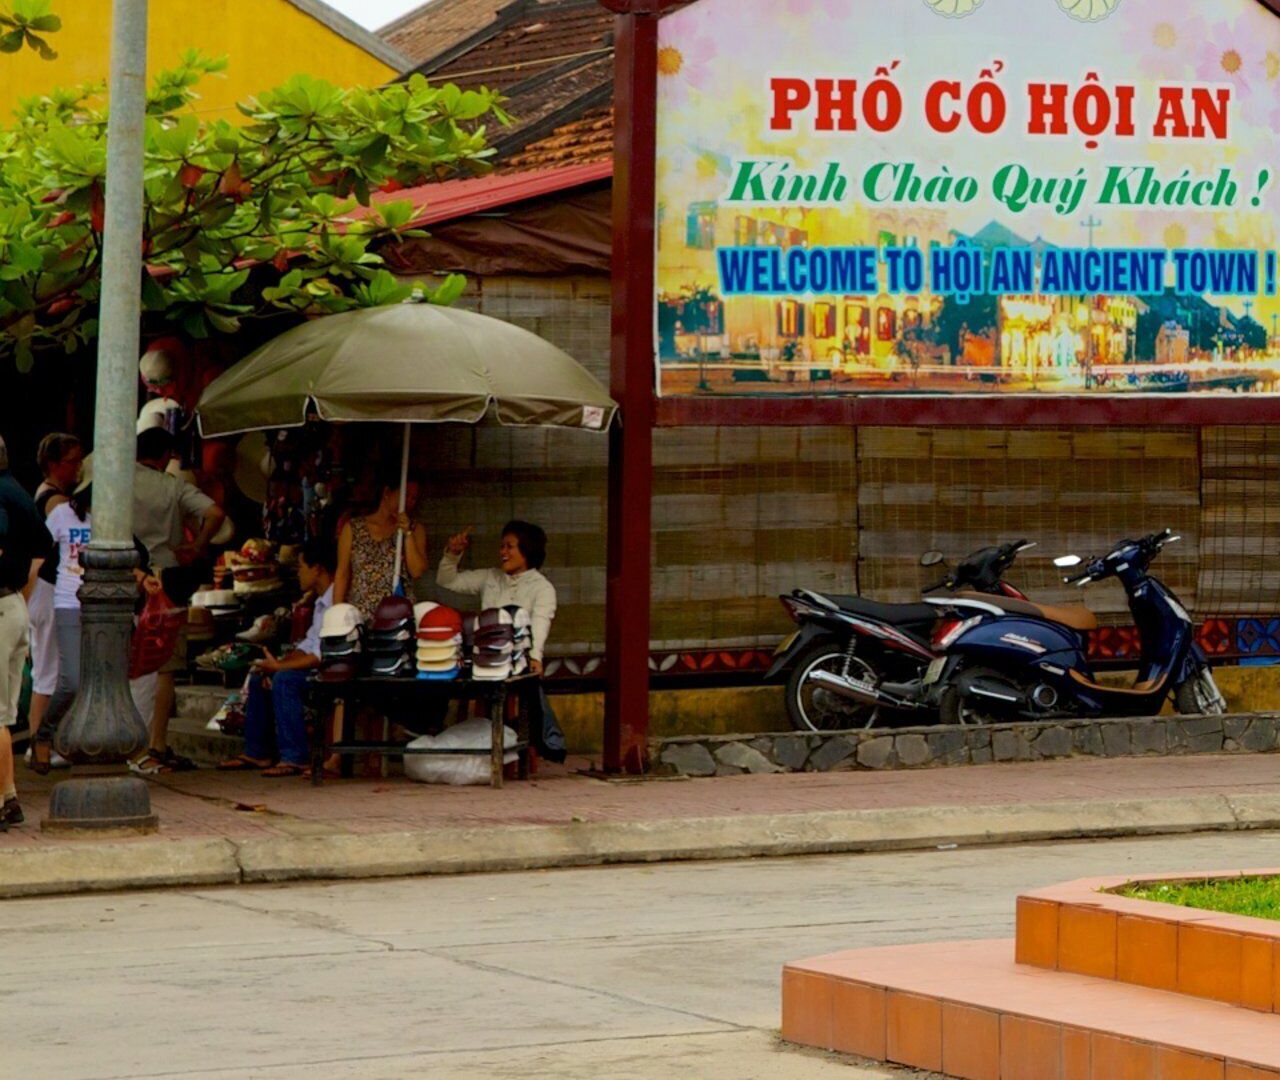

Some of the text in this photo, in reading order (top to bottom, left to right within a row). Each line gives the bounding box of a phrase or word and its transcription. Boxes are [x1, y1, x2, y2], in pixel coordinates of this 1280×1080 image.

[770, 60, 1230, 149] PHỐ CỔ HỘI AN
[726, 161, 847, 203] Kính
[863, 162, 978, 204] Chào
[992, 163, 1088, 215] Quý
[719, 249, 877, 294] WELCOME
[886, 250, 922, 294] TO
[931, 240, 982, 302] HỘI
[992, 251, 1033, 294] AN
[1041, 251, 1165, 294] ANCIENT
[1174, 252, 1257, 294] TOWN
